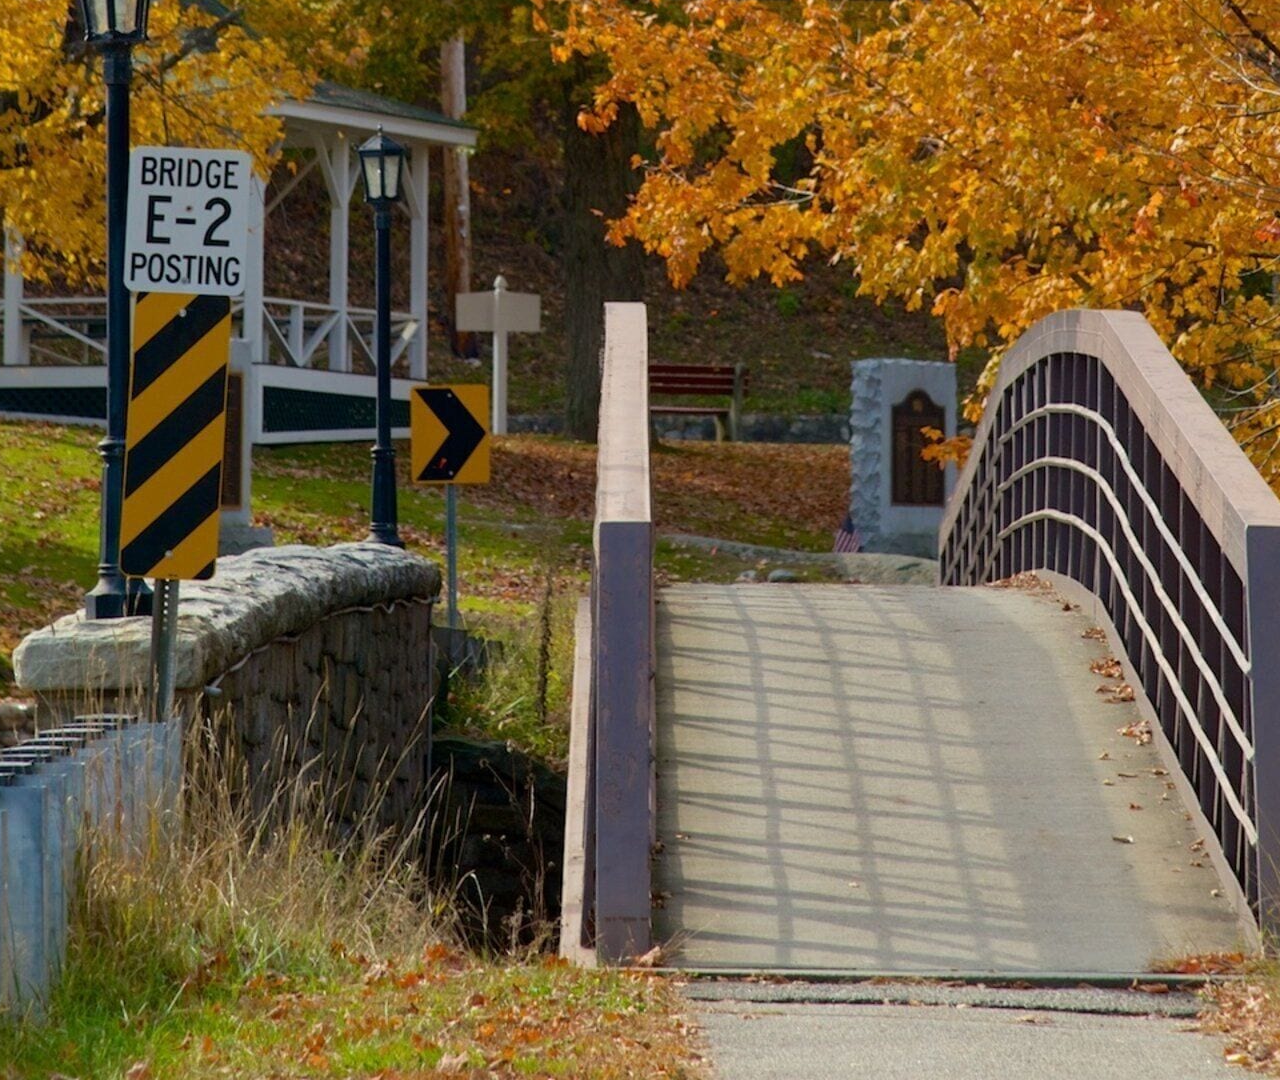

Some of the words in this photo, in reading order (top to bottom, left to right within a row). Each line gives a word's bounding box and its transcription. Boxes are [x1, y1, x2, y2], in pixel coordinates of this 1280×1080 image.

[141, 156, 239, 189] BRIDGE
[146, 195, 231, 247] E-2
[130, 253, 240, 286] POSTING
